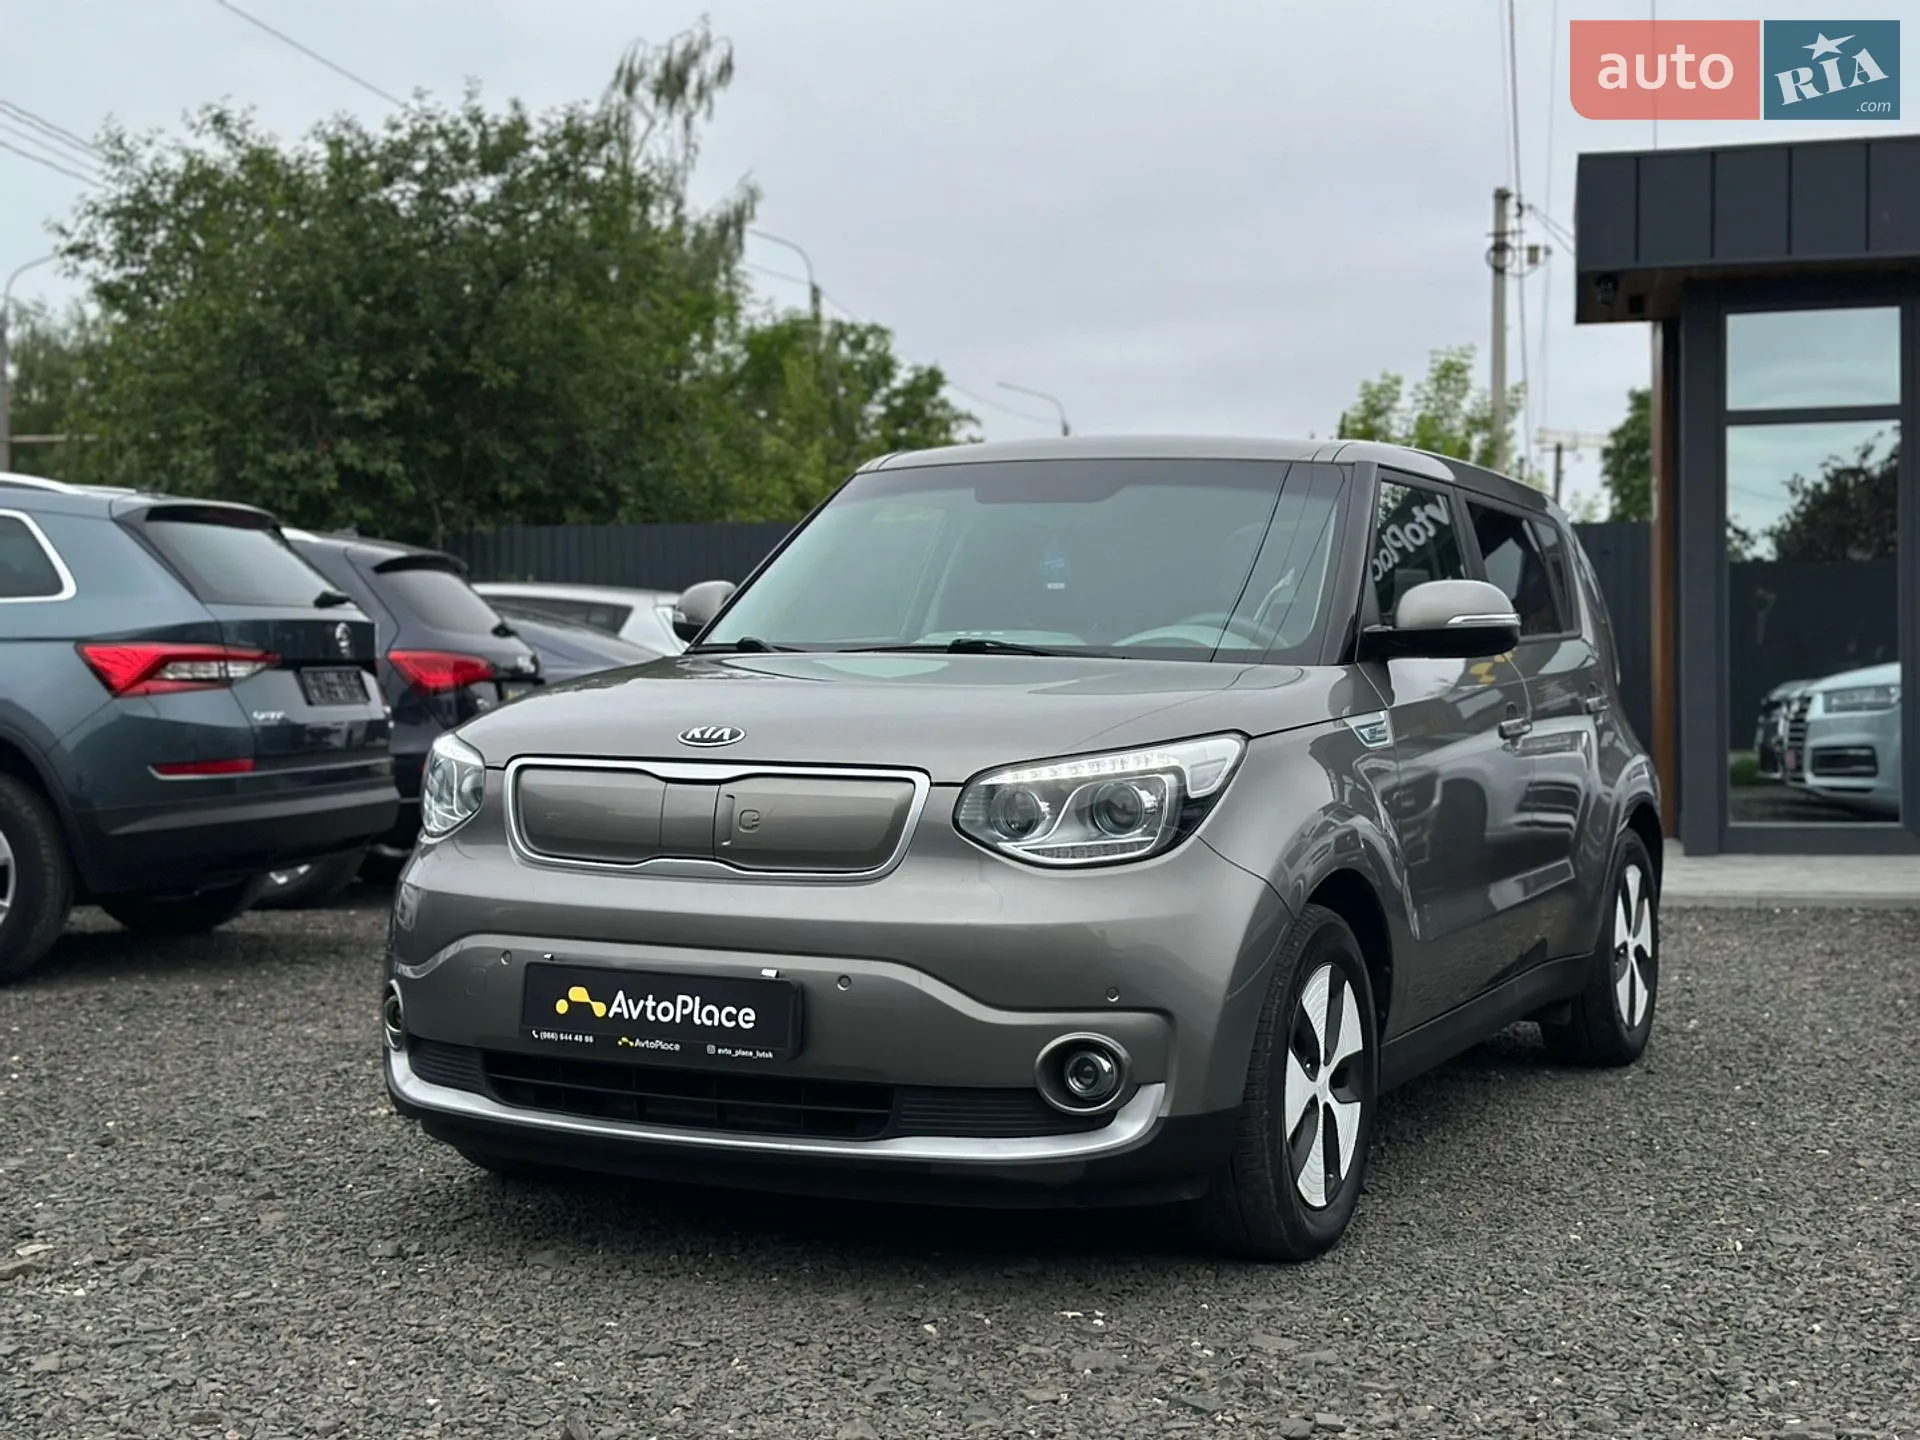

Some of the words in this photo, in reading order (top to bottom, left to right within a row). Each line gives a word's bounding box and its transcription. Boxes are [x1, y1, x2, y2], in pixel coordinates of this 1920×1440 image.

[685, 726, 732, 740] KIA
[607, 989, 757, 1029] AvtoPlace
[634, 1037, 680, 1051] AvtoPlace
